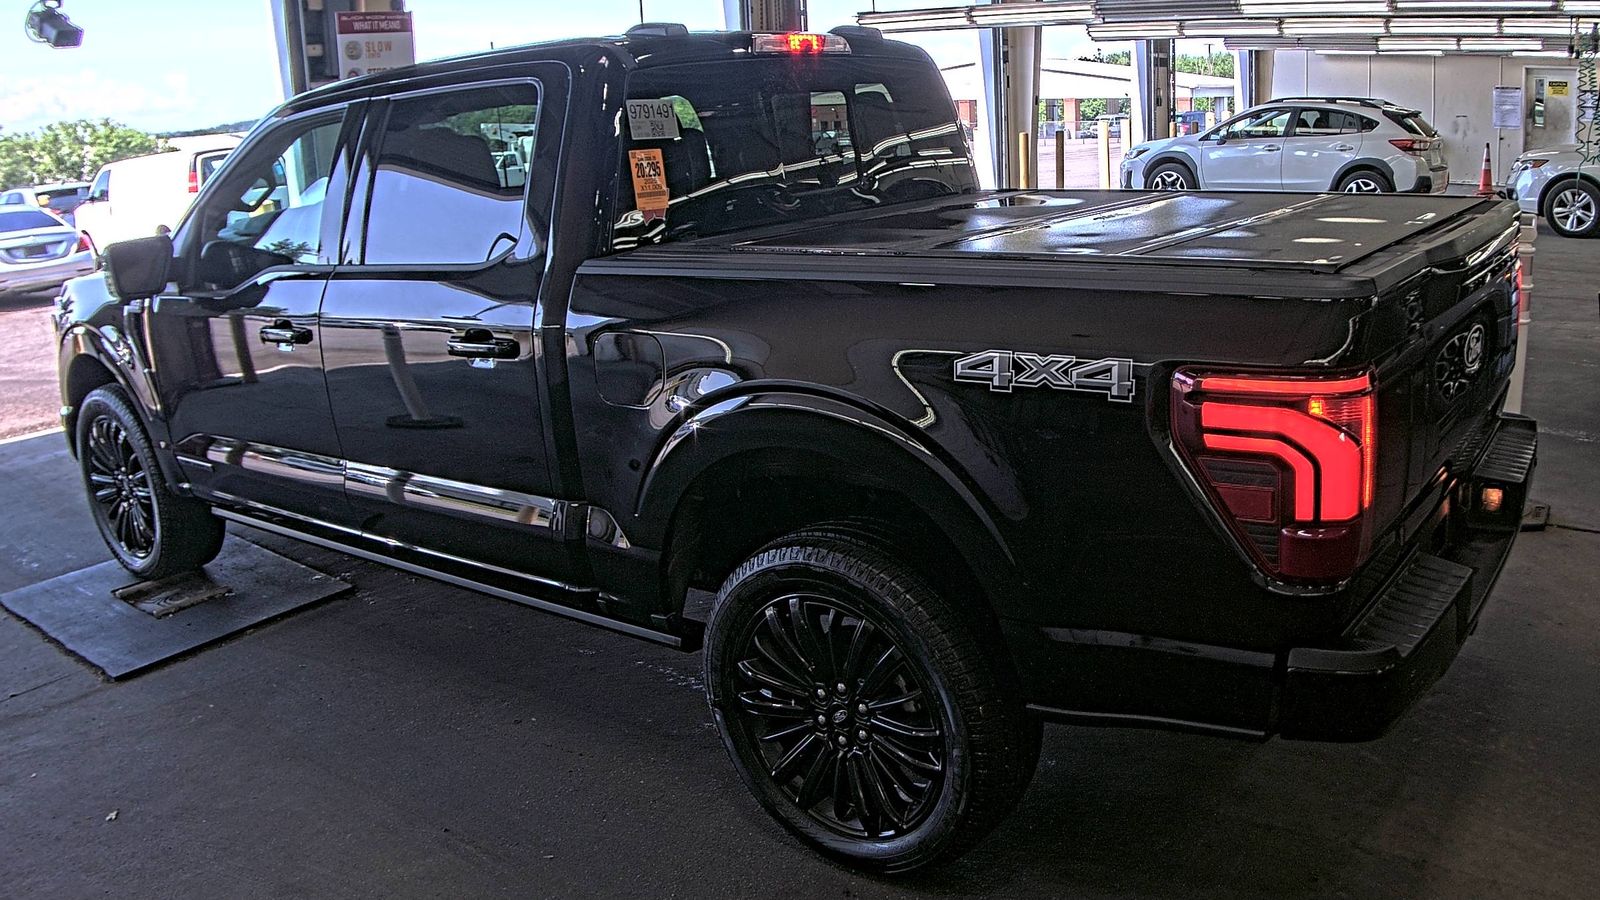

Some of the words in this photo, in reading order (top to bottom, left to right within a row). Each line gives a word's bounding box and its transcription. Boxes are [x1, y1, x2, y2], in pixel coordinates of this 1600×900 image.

[353, 21, 371, 30] WHAT
[372, 21, 378, 30] IT
[379, 20, 401, 30] MEANS
[365, 41, 392, 52] SLOW
[629, 103, 675, 119] 9791491
